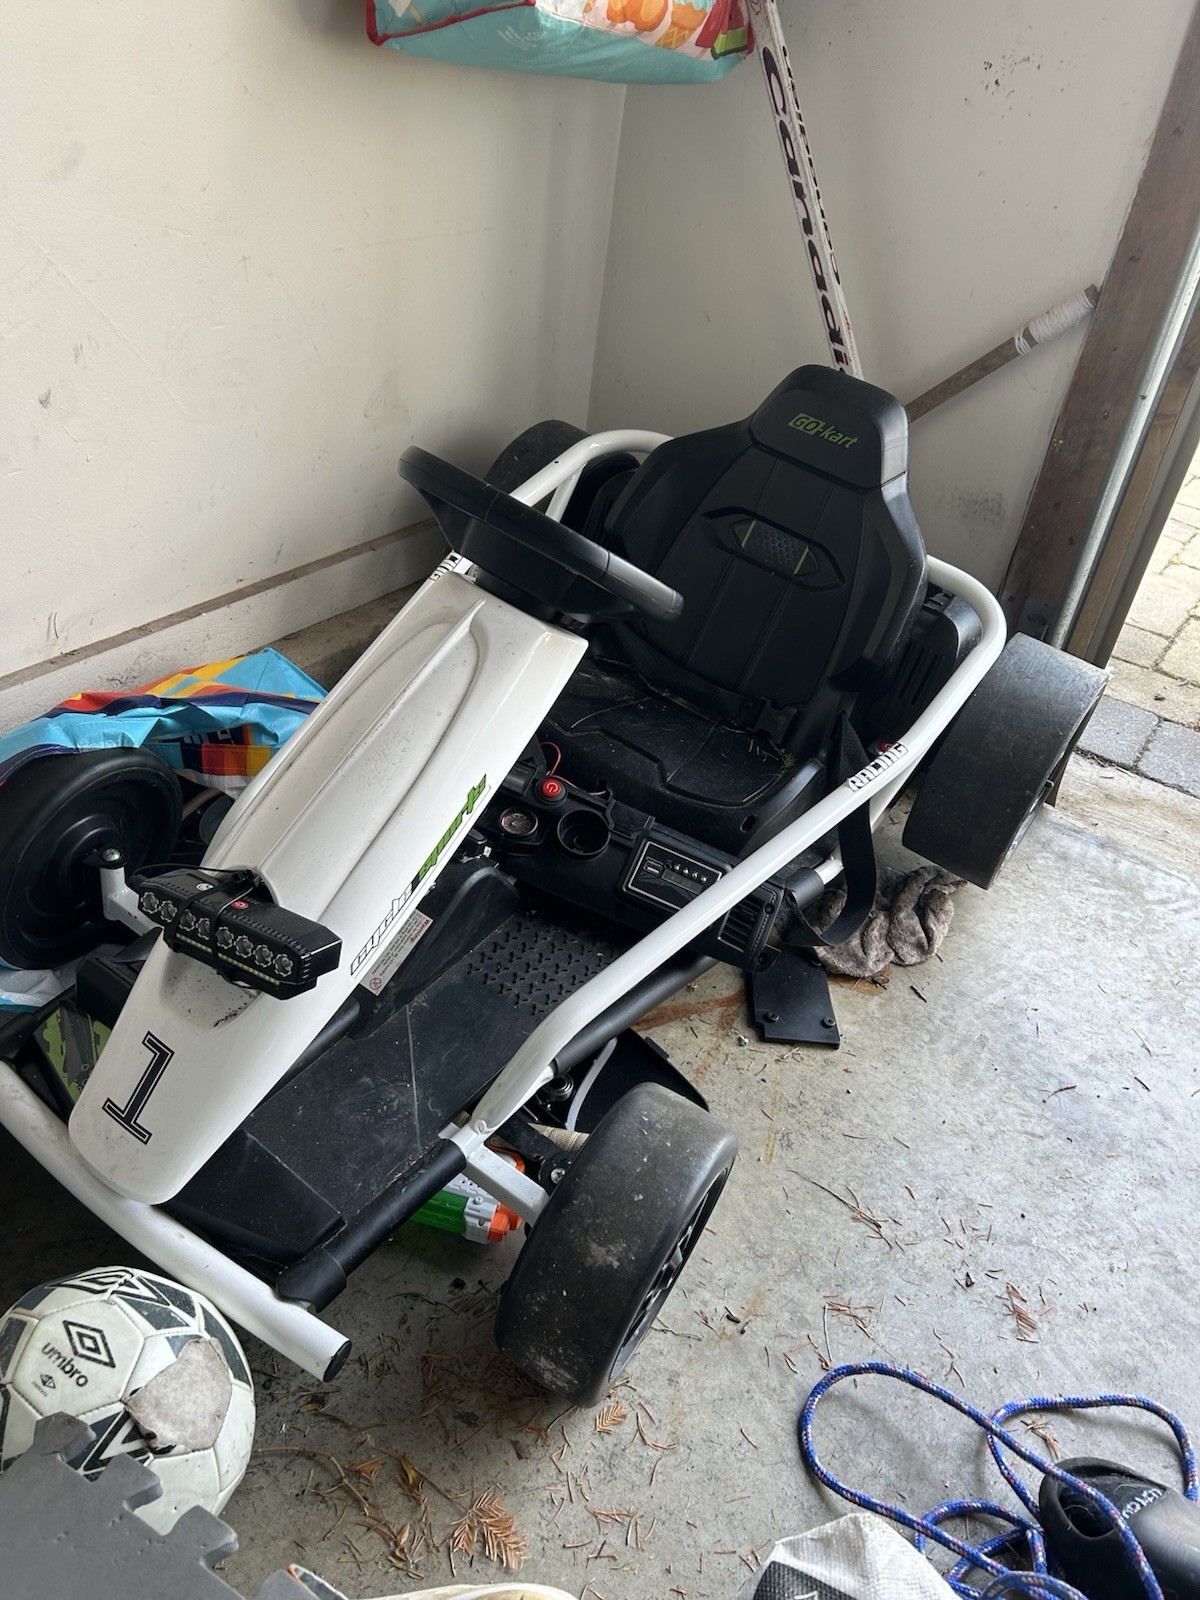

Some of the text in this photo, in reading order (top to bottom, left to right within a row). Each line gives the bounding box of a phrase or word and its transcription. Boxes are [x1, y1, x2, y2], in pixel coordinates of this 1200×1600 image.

[763, 46, 850, 372] Canadi
[102, 1031, 175, 1145] 1
[41, 1342, 88, 1387] umbro
